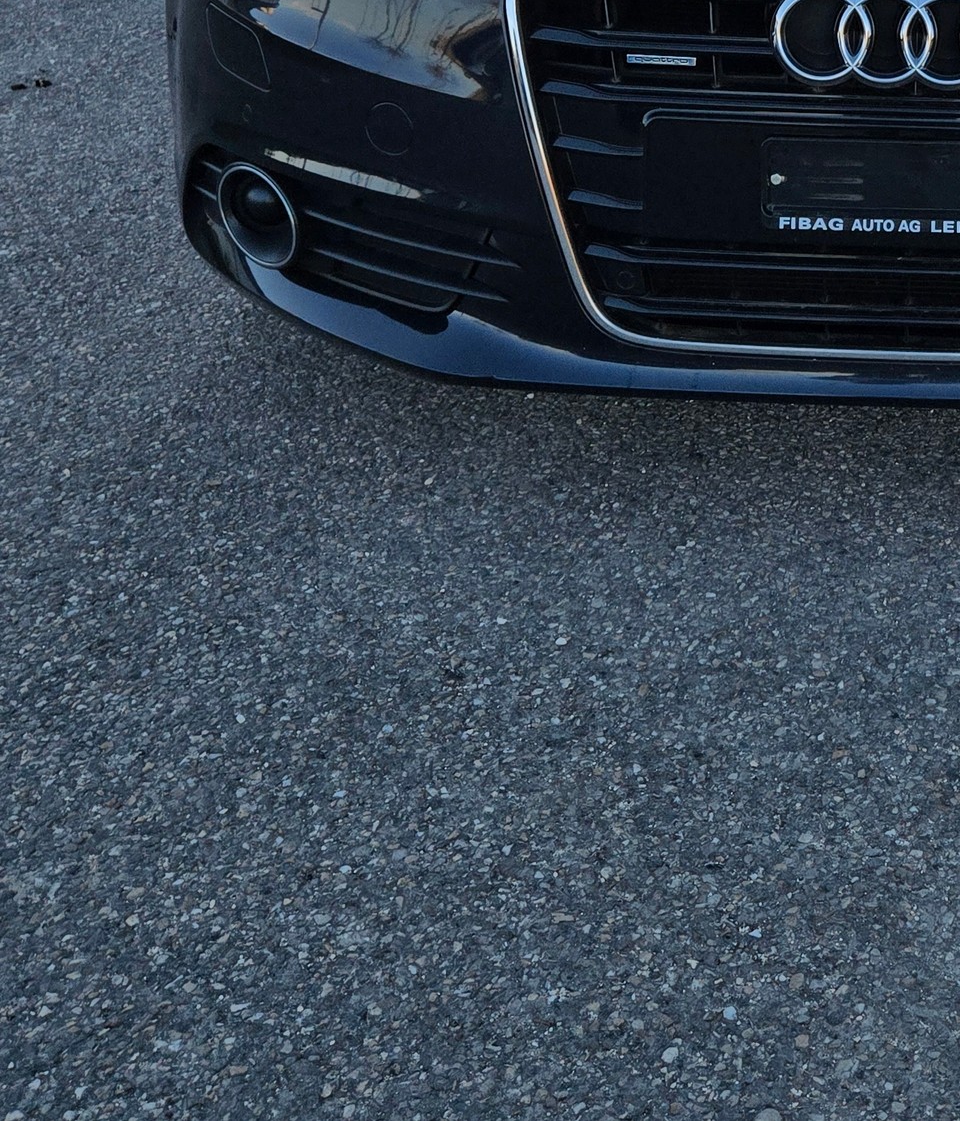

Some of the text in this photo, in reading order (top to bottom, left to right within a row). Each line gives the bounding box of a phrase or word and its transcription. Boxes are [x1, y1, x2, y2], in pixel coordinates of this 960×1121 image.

[778, 216, 844, 232] FIBAG
[851, 218, 894, 232] AUTO
[898, 219, 921, 233] AG
